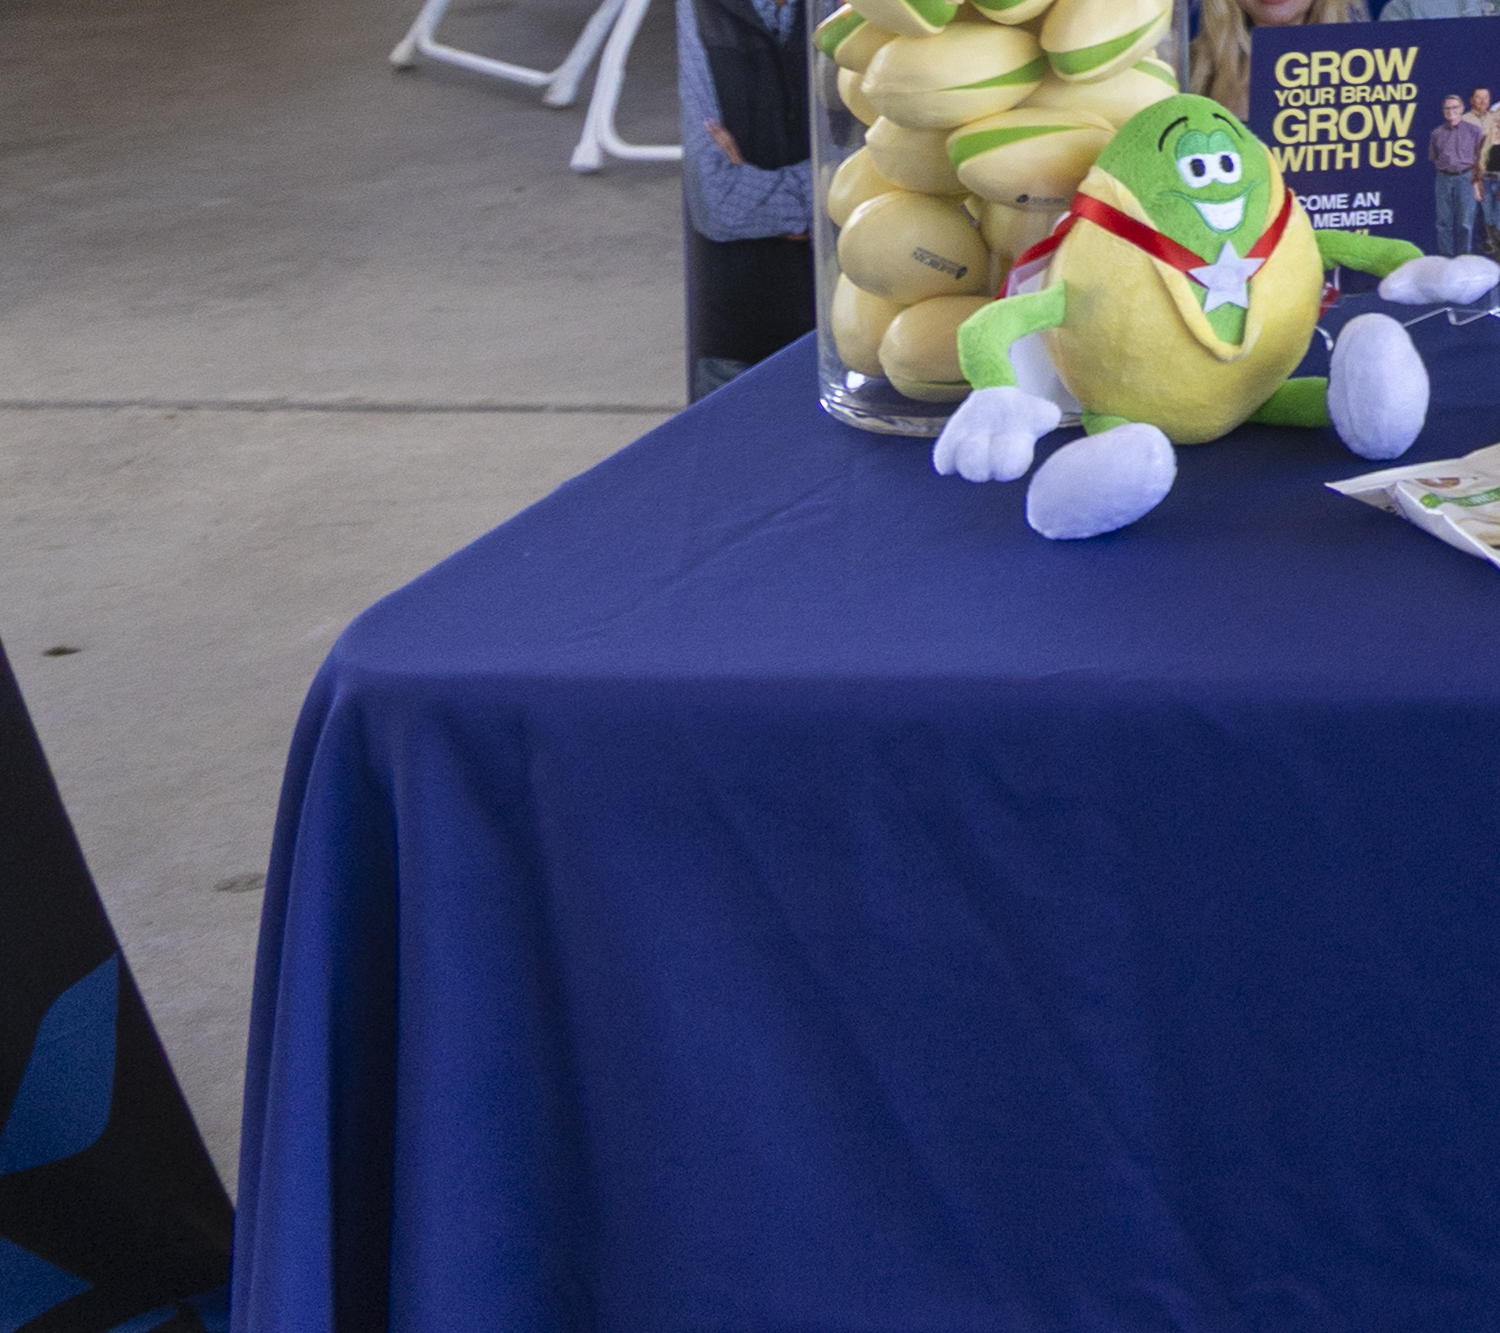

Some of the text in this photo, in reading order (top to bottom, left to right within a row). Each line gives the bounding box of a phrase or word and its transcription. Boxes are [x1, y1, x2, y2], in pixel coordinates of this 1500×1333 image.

[1275, 47, 1418, 87] GROW
[1274, 83, 1417, 107] YOUR BRAND
[1272, 103, 1416, 144] GROW
[1272, 140, 1415, 173] WITH US
[1353, 192, 1381, 208] AN
[1313, 210, 1393, 228] MEMBER
